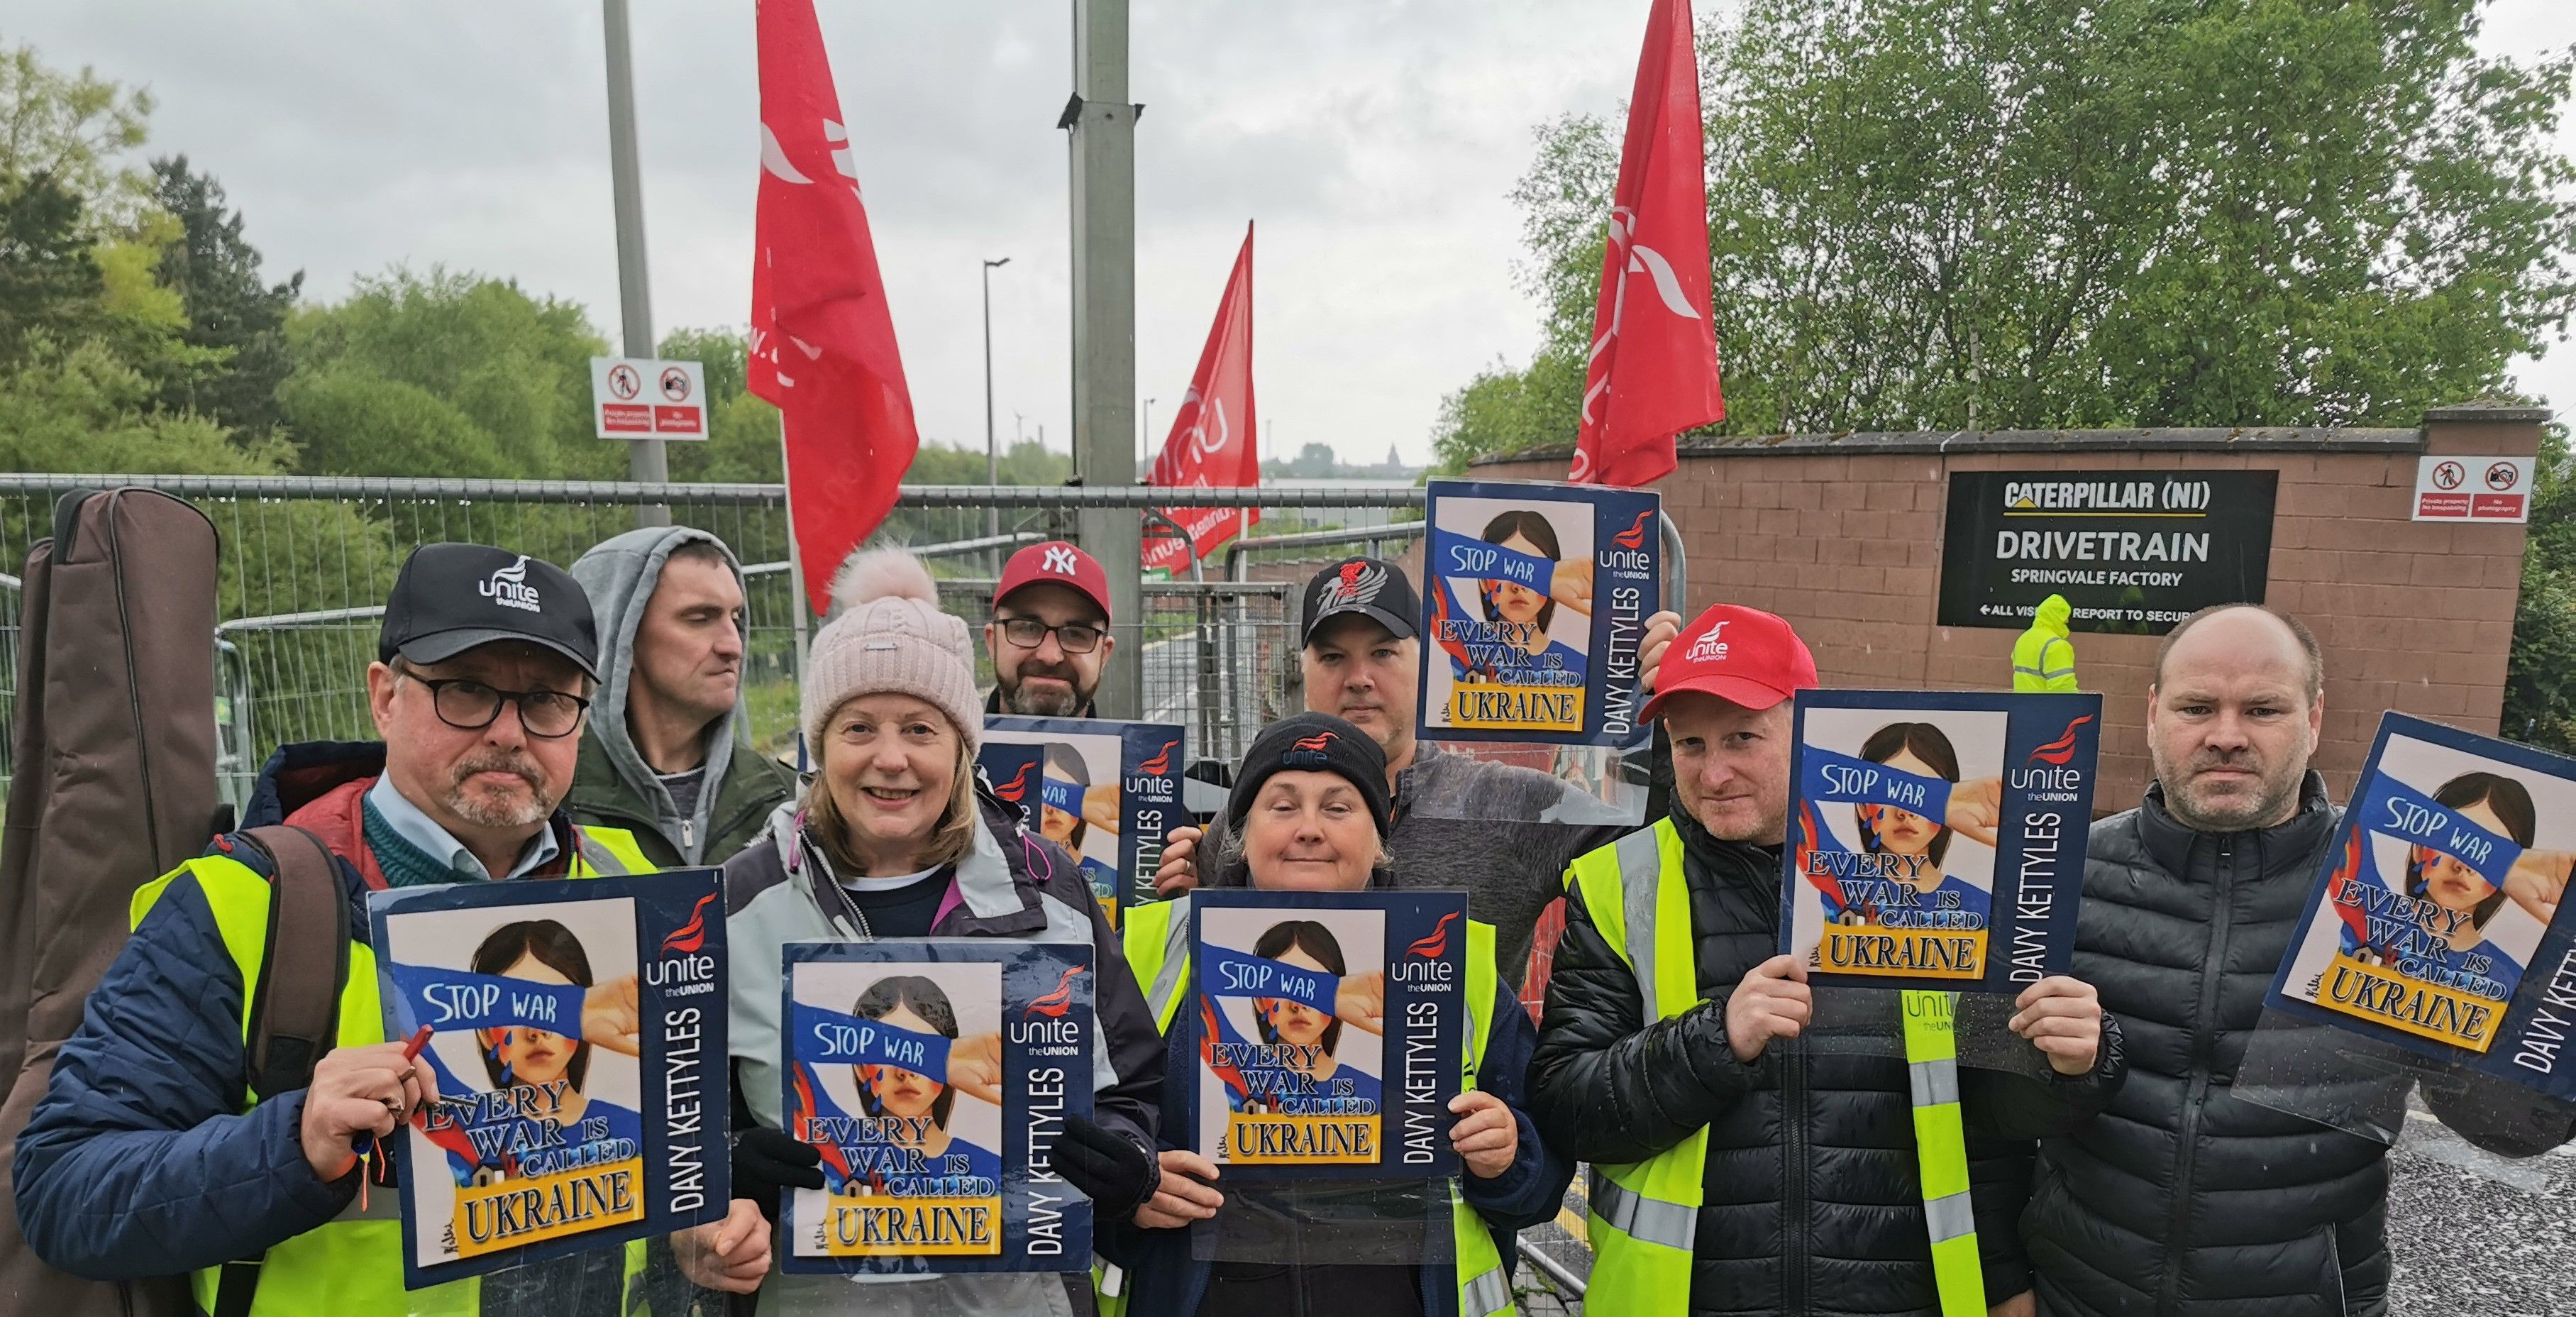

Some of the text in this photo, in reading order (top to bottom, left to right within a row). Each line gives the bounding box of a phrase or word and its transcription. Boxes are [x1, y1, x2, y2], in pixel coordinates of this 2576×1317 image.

[2004, 481, 2211, 510] CATERPILLAR (NI)
[1042, 546, 1078, 575] NY
[1599, 548, 1649, 571] unite
[1996, 530, 2210, 563] DRIVETRAIN
[1451, 546, 1534, 582] STOP WAR
[2011, 568, 2183, 587] SPRINGVALE FACTORY
[480, 580, 539, 604] unite
[1991, 605, 2013, 616] ALL
[2072, 607, 2123, 620] REPORT
[2126, 610, 2143, 621] TO
[2146, 611, 2195, 622] SECUR
[1439, 619, 1538, 645] EVERY
[1465, 644, 1563, 668] WAR IS
[1603, 587, 1640, 734] DAVY KETTYLES
[1685, 641, 1728, 660] unite
[1497, 669, 1581, 687] CALLED
[1458, 691, 1576, 722] UKRAINE
[1283, 749, 1329, 765] unite
[1126, 775, 1174, 794] unite
[1821, 764, 1925, 806] STOP WAR
[2011, 764, 2081, 790] unite
[2028, 792, 2078, 803] theUNION
[2384, 795, 2492, 865] STOP WAR
[1806, 851, 1929, 879] EVERY
[1837, 880, 1960, 908] WAR IS
[2009, 812, 2061, 983] DAVY KETTYLES
[2334, 877, 2474, 937] EVERY
[1880, 910, 1983, 930] CALLED
[1830, 933, 1975, 971] UKRAINE
[2365, 916, 2492, 974] WAR IS
[646, 954, 714, 987] unite
[1219, 961, 1316, 1001] STOP WAR
[1391, 958, 1452, 982] unite
[2397, 959, 2506, 1001] CALLED
[1408, 983, 1452, 992] theUNION
[423, 983, 557, 1023] STOP WAR
[1906, 991, 1951, 1017] unit
[2330, 965, 2491, 1040] UKRAINE
[814, 1023, 925, 1067] STOP WAR
[1010, 1017, 1079, 1044] unite
[2513, 1007, 2571, 1074] DAVY
[1029, 1046, 1078, 1056] theUNION
[1209, 1043, 1323, 1068] EVERY
[1241, 1070, 1354, 1095] WAR IS
[1403, 1002, 1438, 1164] DAVY KETTYLES
[423, 1080, 568, 1132] EVERY
[666, 1008, 704, 1213] DAVY KETTYLES
[1281, 1098, 1376, 1115] CALLED
[468, 1115, 609, 1161] WAR IS
[806, 1116, 934, 1144] EVERY
[1236, 1122, 1372, 1157] UKRAINE
[521, 1136, 636, 1178] CALLED
[841, 1147, 969, 1174] WAR IS
[1027, 1068, 1064, 1255] DAVY KETTYLES
[888, 1177, 994, 1197] CALLED
[465, 1170, 635, 1243] UKRAINE
[836, 1206, 990, 1245] UKRAINE
